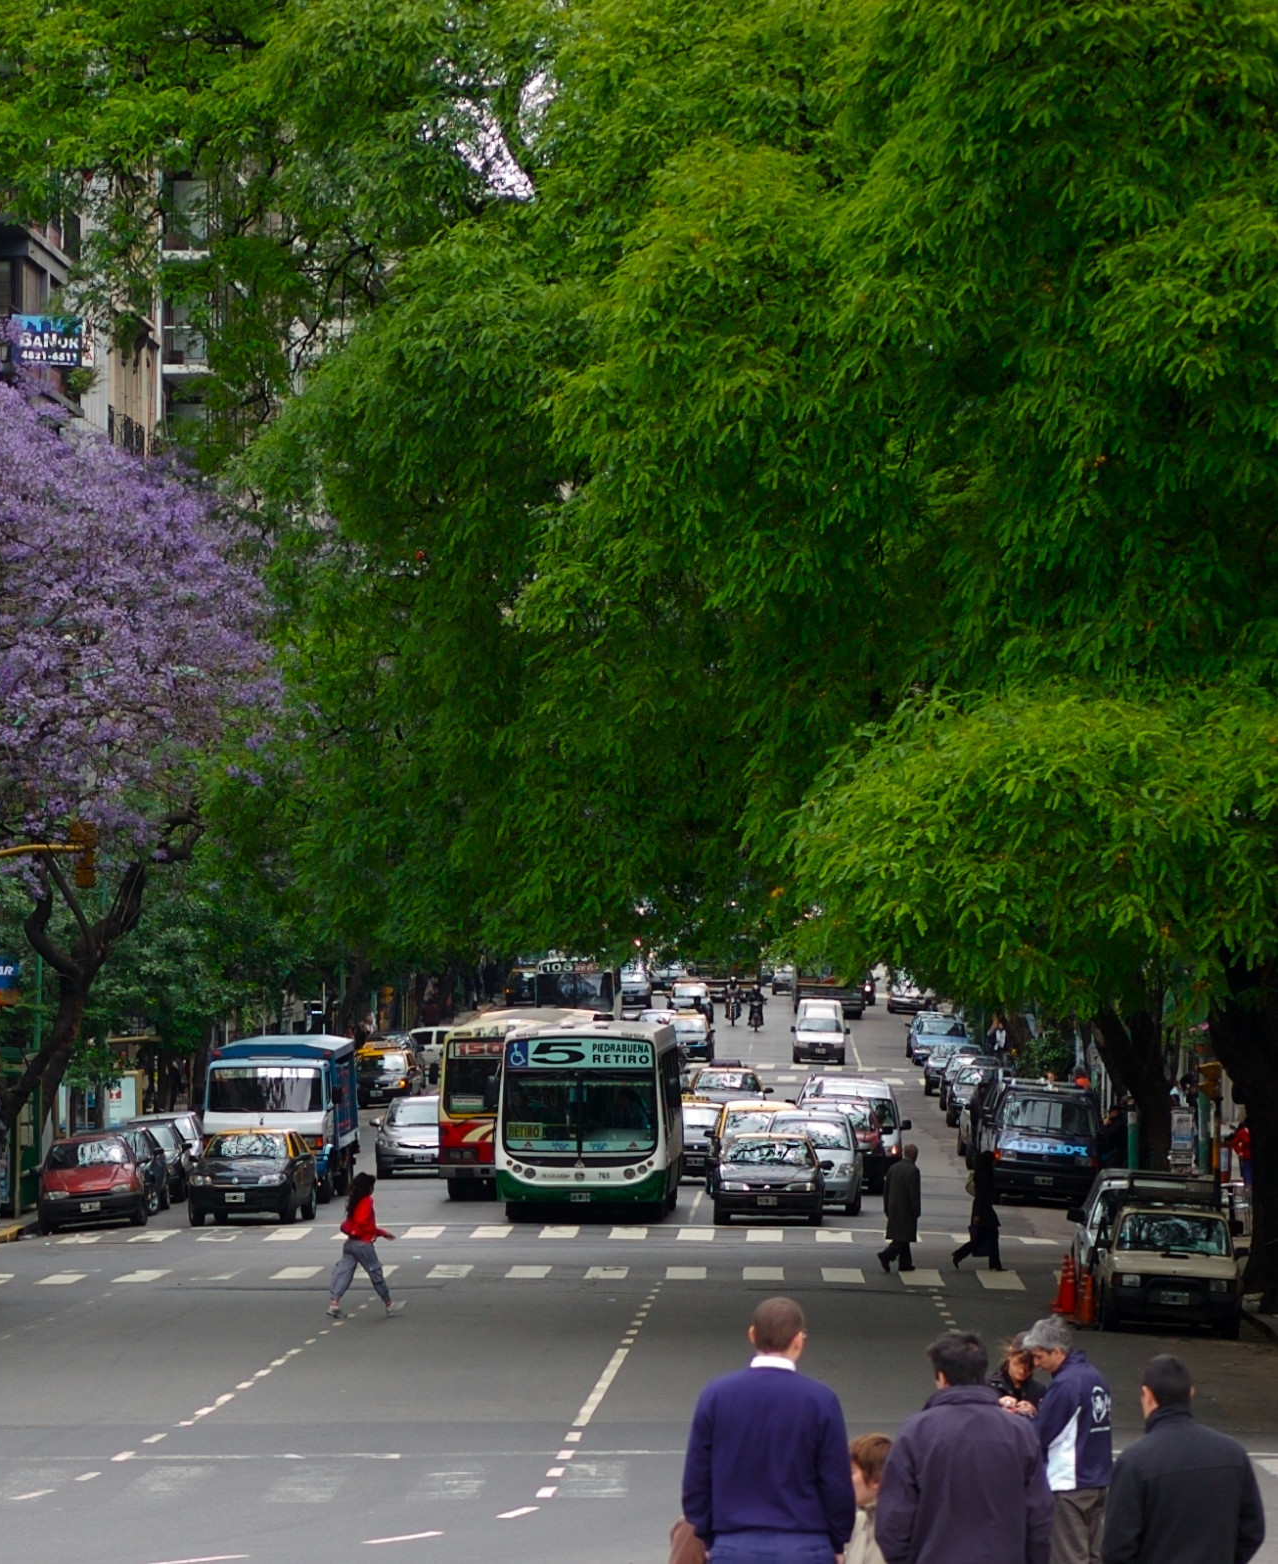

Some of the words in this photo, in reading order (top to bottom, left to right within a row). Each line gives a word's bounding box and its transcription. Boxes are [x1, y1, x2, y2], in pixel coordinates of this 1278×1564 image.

[457, 1042, 505, 1056] 150
[530, 1041, 585, 1065] 5
[592, 1043, 650, 1053] PIEDRABUENA
[592, 1054, 650, 1065] RETIRO
[508, 1125, 540, 1138] RETIRO
